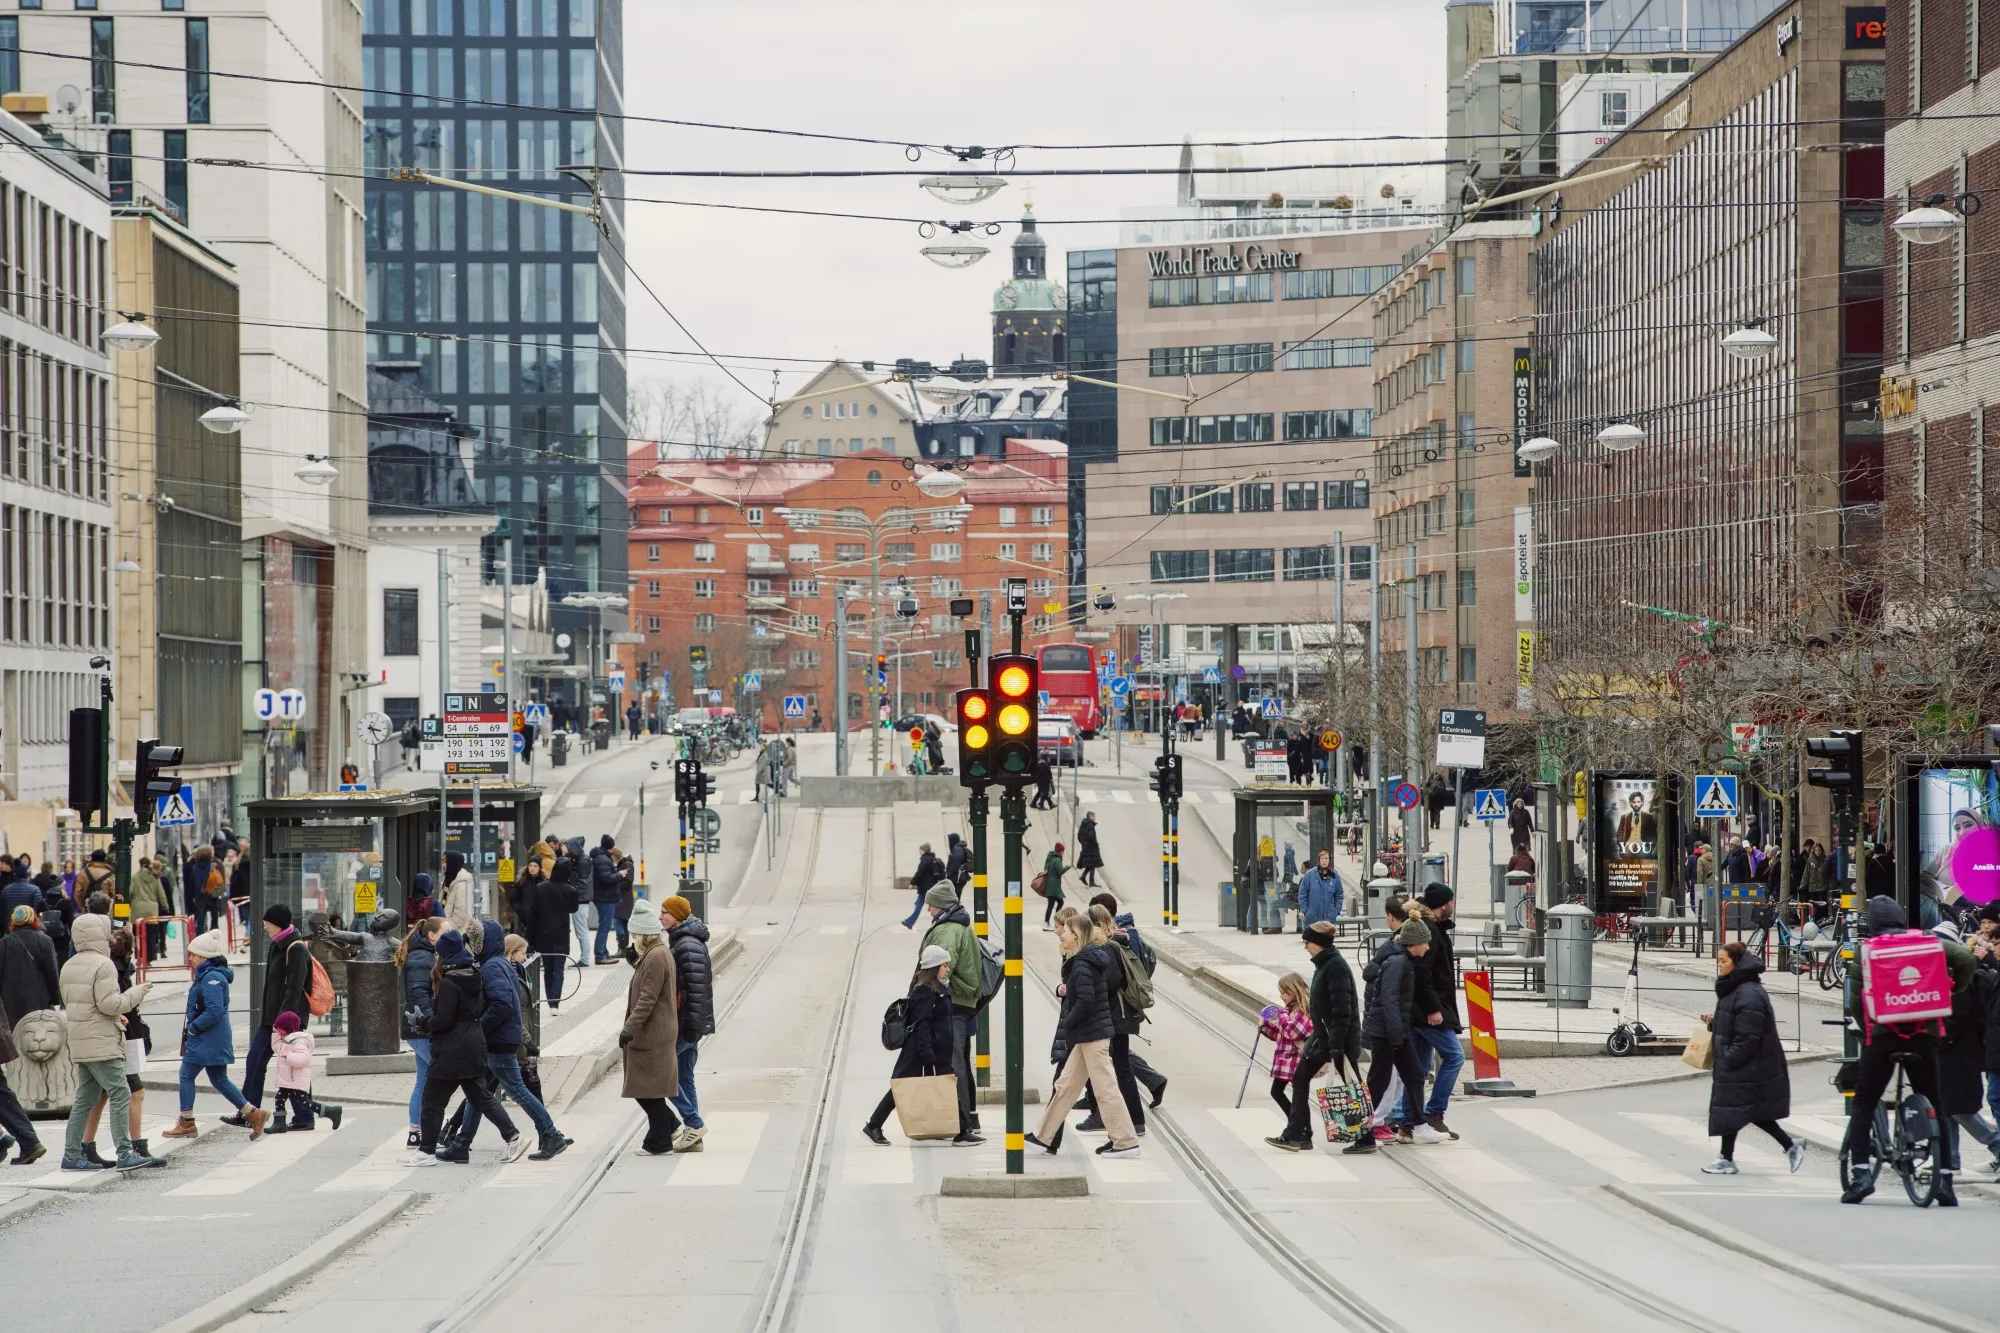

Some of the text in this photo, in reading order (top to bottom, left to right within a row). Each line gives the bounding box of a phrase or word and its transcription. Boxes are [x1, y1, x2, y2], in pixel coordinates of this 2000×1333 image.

[1147, 245, 1301, 276] World Trade Center
[1516, 377, 1529, 467] McDonals
[1520, 637, 1530, 673] Hertz
[260, 693, 272, 716] J
[281, 696, 292, 715] T
[468, 698, 478, 710] N
[489, 724, 500, 732] 69
[1442, 725, 1472, 734] T-Centralen
[447, 739, 506, 748] 190 191 192
[839, 739, 845, 748] 2
[1323, 734, 1338, 746] 40
[447, 749, 506, 758] 193 194 195
[680, 762, 686, 772] S
[1168, 757, 1175, 768] S
[1619, 842, 1653, 854] YOU
[1973, 863, 1995, 871] Ansök
[1885, 989, 1941, 1006] foodora
